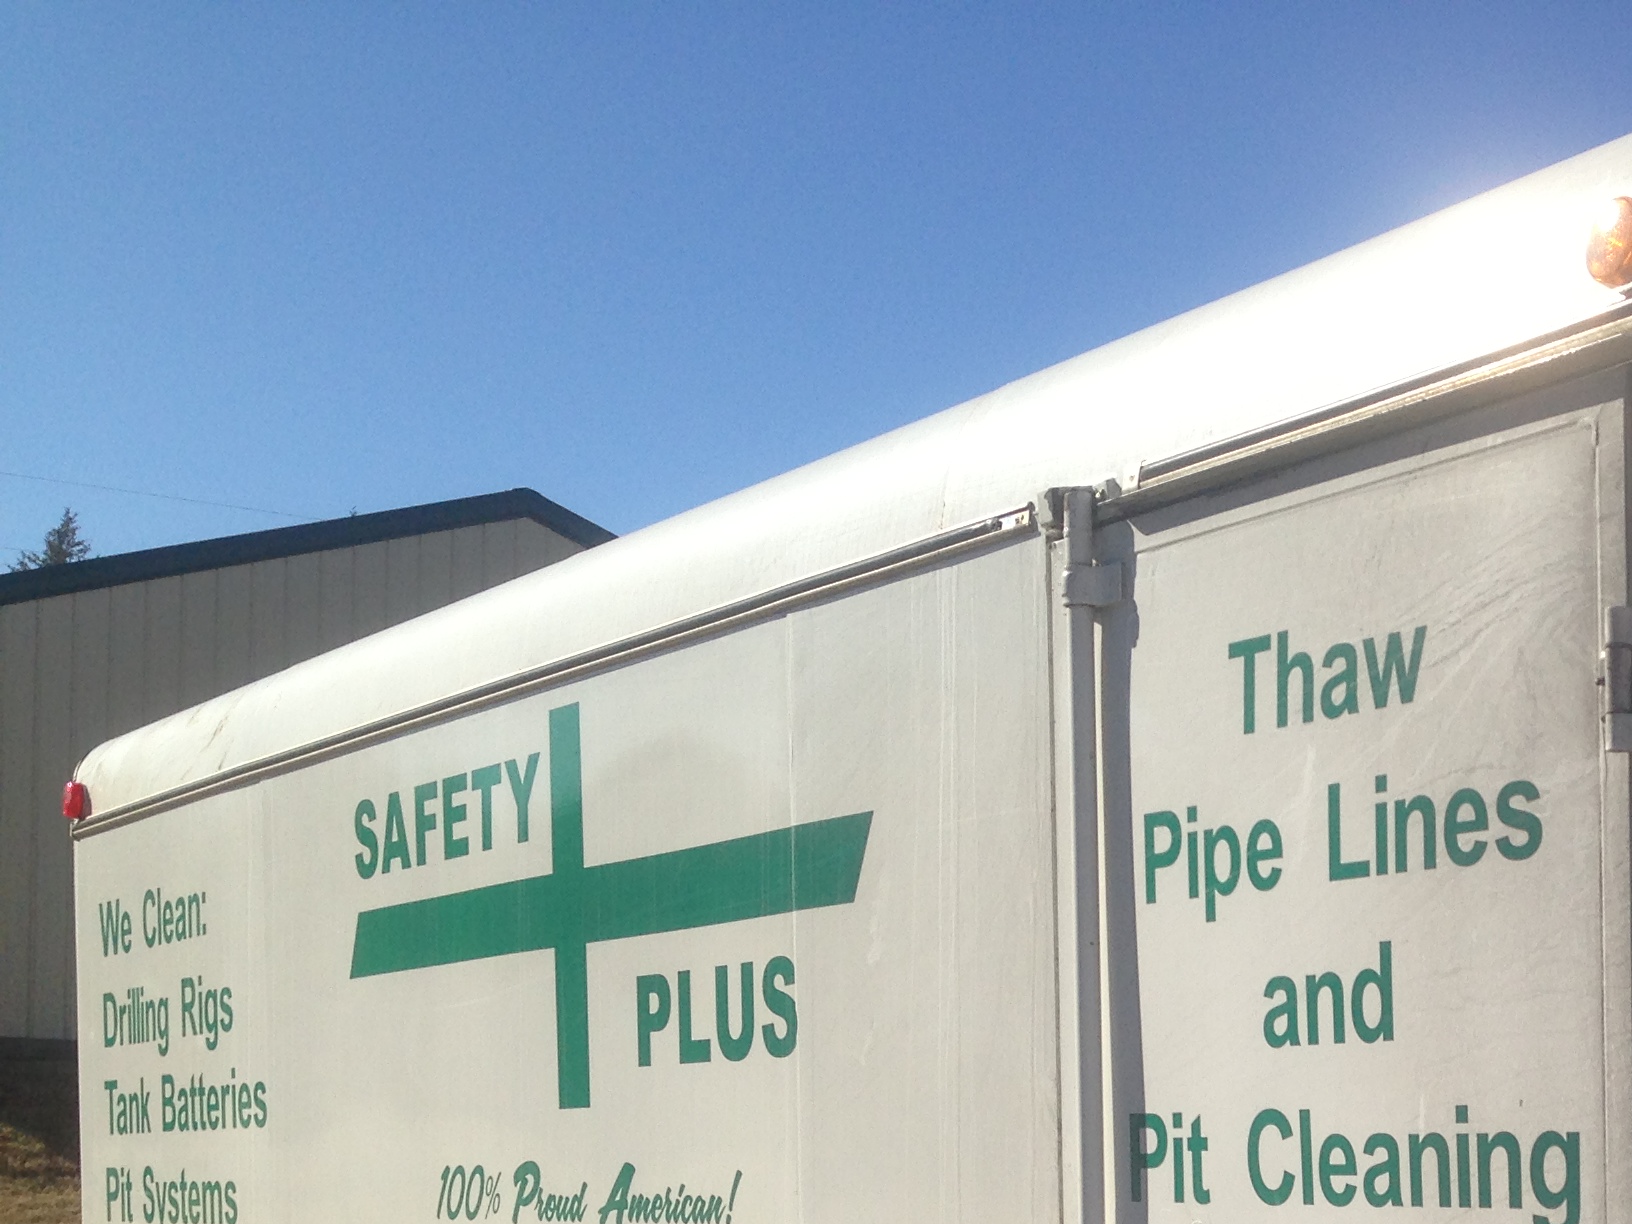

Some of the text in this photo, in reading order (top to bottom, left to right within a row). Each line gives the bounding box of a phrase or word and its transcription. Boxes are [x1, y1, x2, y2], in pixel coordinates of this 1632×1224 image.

[1228, 626, 1427, 735] Thaw
[353, 752, 541, 880] SAFETY
[1143, 774, 1543, 923] Pipe Lines
[98, 887, 208, 958] We Clean:
[103, 976, 233, 1056] Drilling Rigs
[636, 955, 798, 1067] PLUS
[1262, 940, 1395, 1049] and
[104, 1068, 268, 1137] Tank Batteries
[105, 1166, 134, 1224] Pit
[436, 1164, 501, 1221] 100%
[1128, 1112, 1211, 1204] Pit
